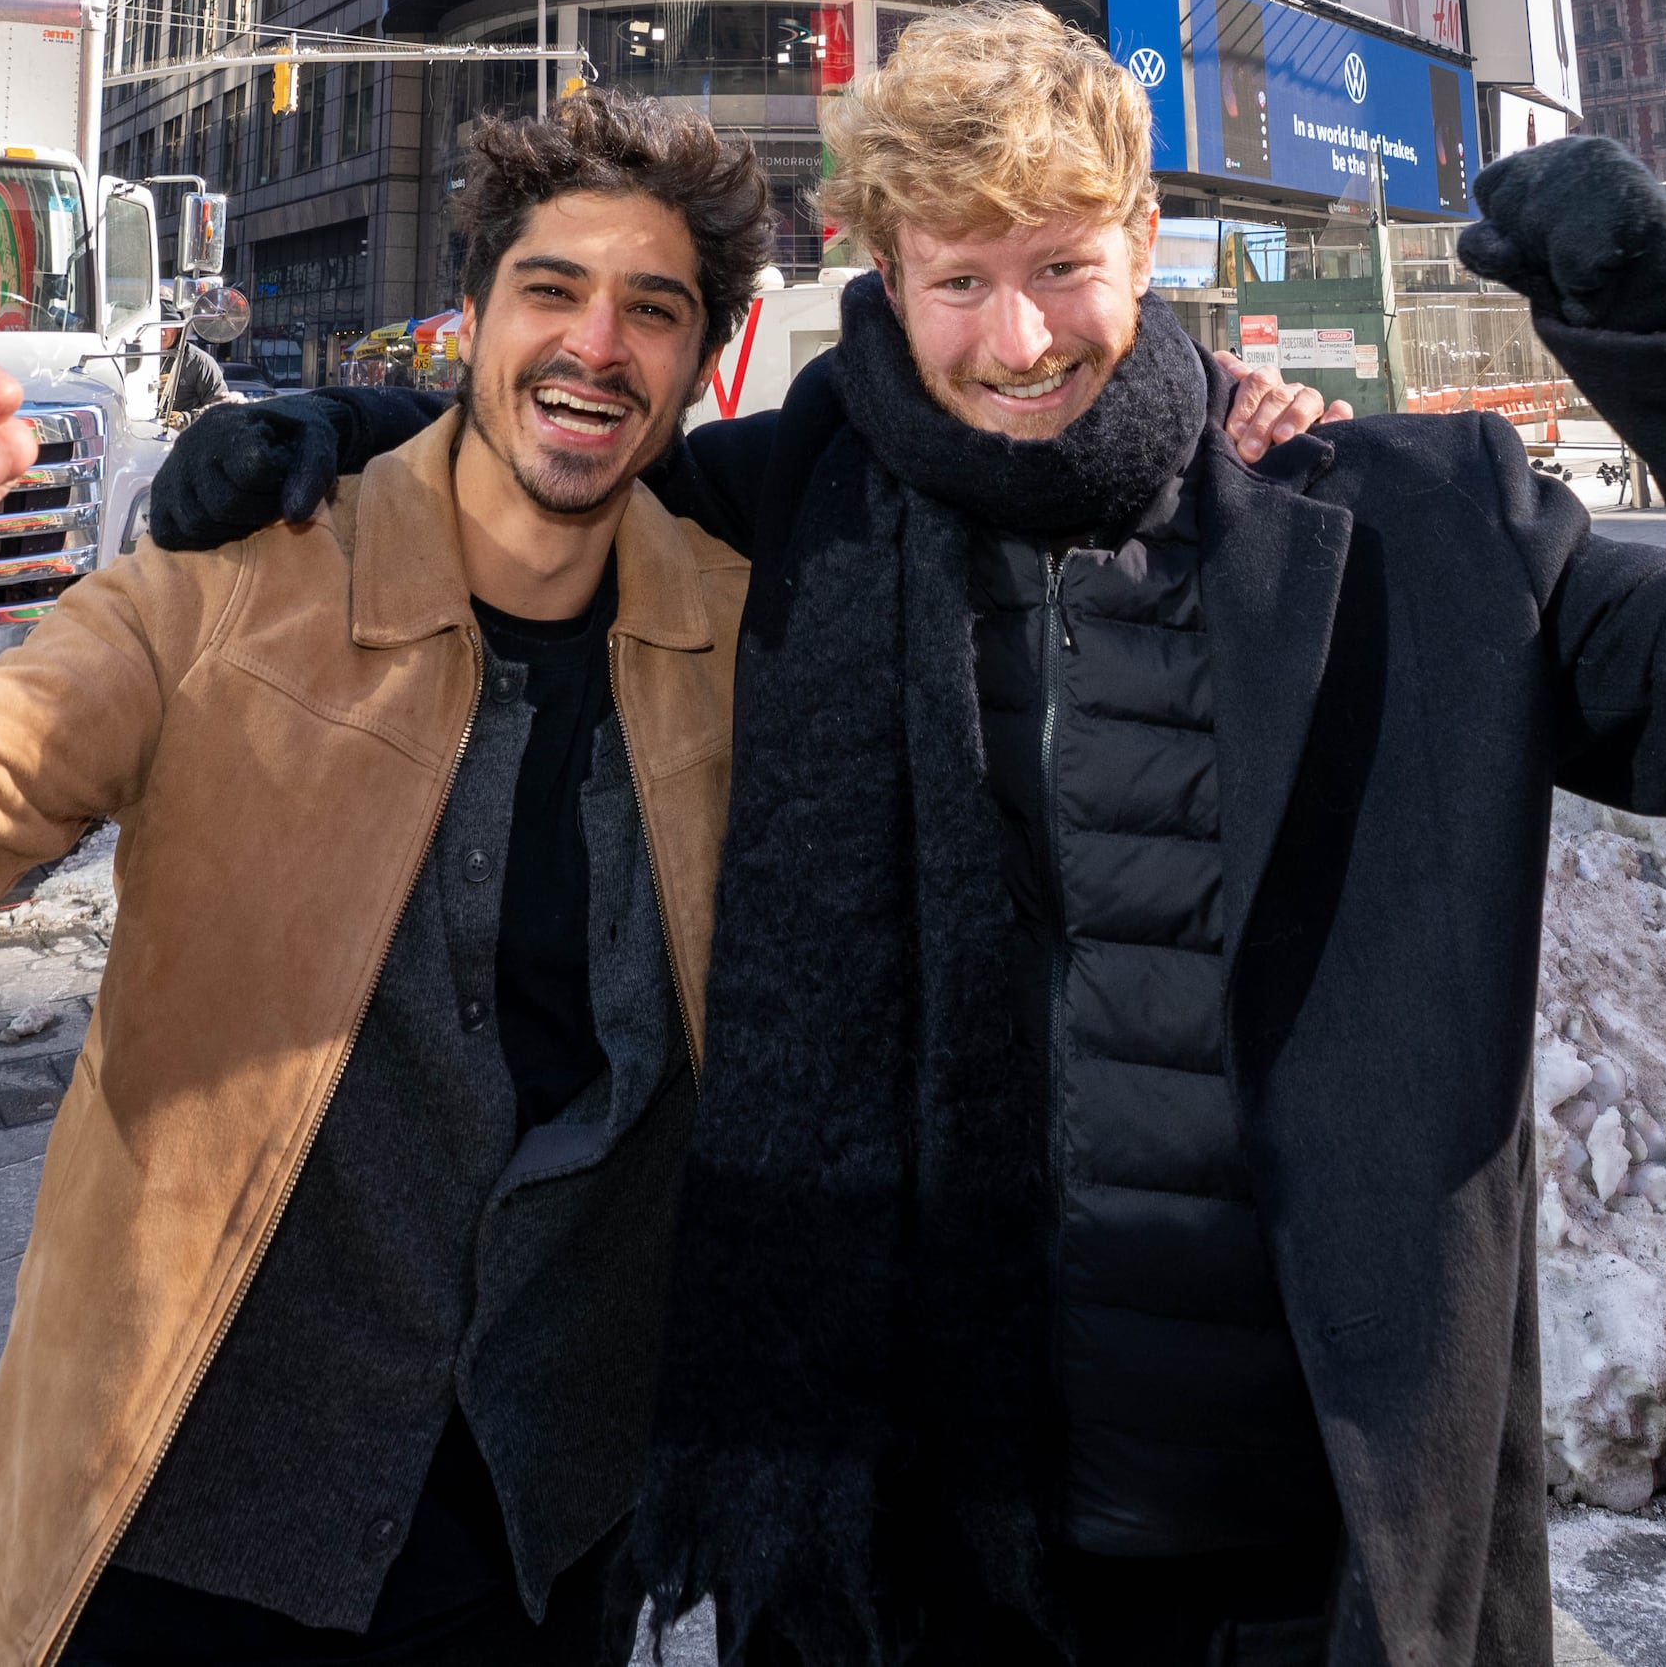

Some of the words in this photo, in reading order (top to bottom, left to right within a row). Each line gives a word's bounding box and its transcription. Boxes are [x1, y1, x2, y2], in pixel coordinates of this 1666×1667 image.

[1293, 114, 1305, 137] In
[1307, 122, 1315, 139] a
[1316, 124, 1349, 147] world
[1350, 127, 1368, 151] full
[1370, 134, 1381, 153] of
[1382, 135, 1418, 166] brakes,
[757, 157, 823, 167] TOMORROW
[1332, 149, 1346, 172] be
[1347, 154, 1366, 175] the
[1281, 337, 1314, 349] PEDESTRIANS
[1247, 352, 1275, 364] SUBWAY
